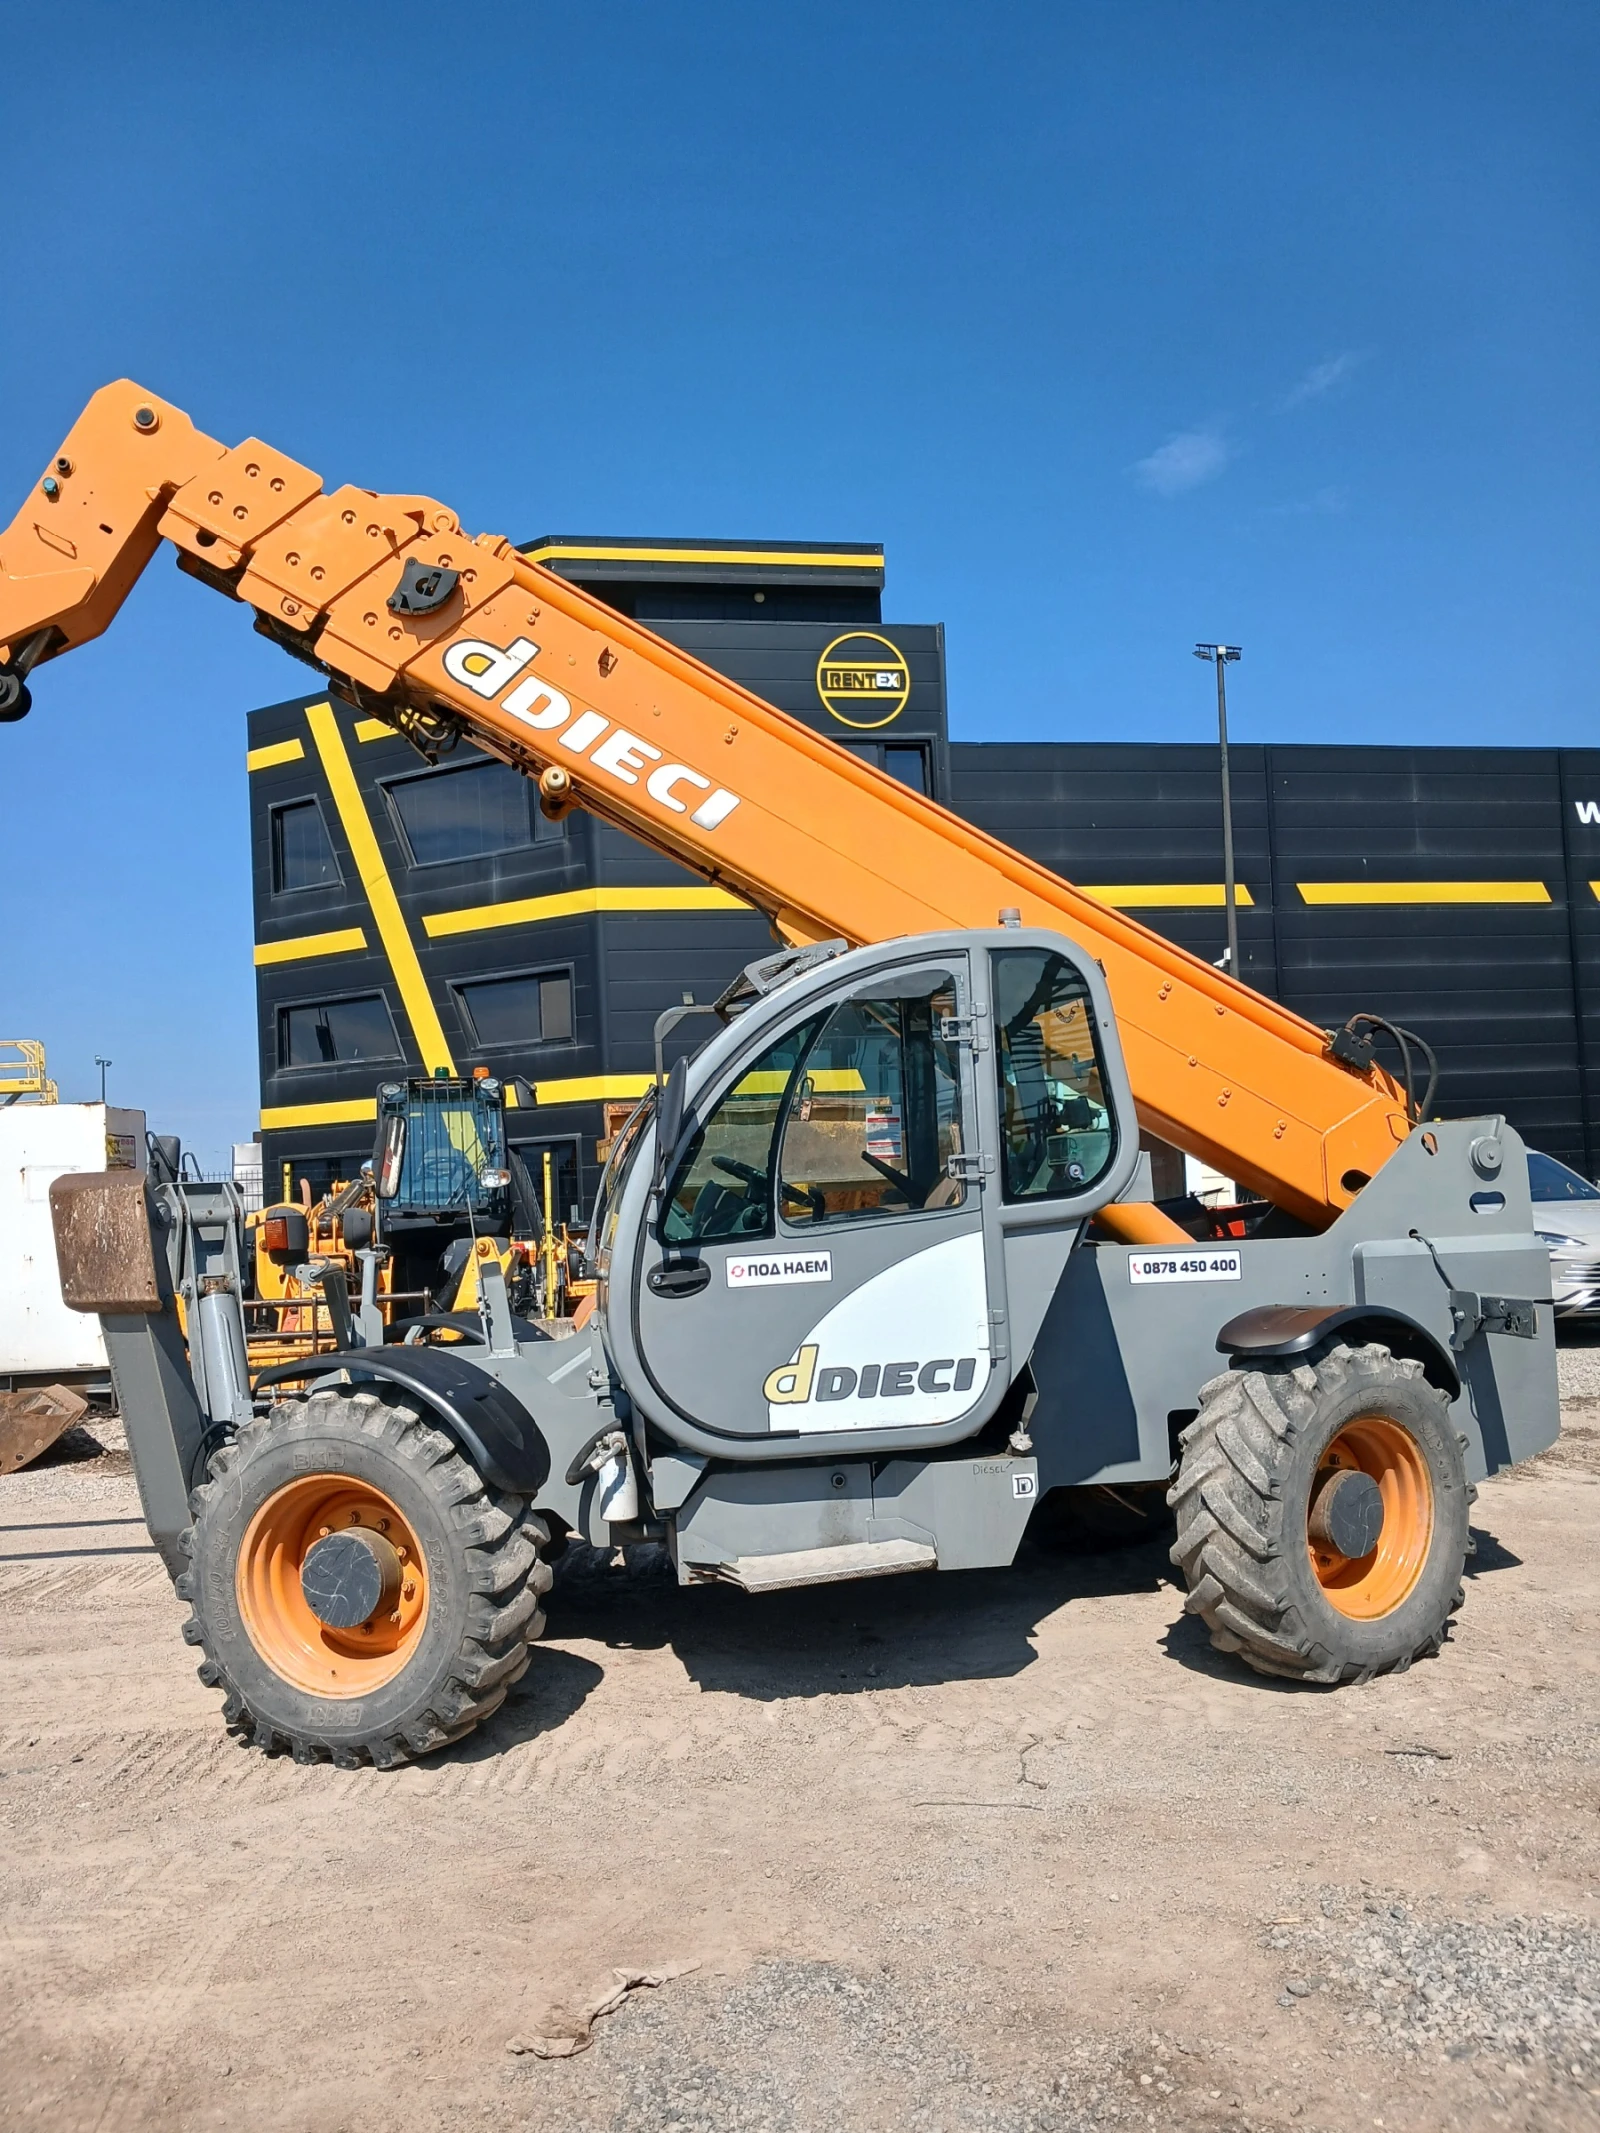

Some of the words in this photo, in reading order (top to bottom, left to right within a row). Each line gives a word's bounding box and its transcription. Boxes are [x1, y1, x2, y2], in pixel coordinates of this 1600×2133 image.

[827, 671, 901, 689] RENTEX
[748, 1263, 781, 1276] ПОД
[783, 1260, 828, 1274] НАЕМ
[1143, 1262, 1177, 1274] 0878
[1180, 1261, 1207, 1272] 450
[1210, 1259, 1237, 1271] 400
[1014, 1477, 1033, 1495] D
